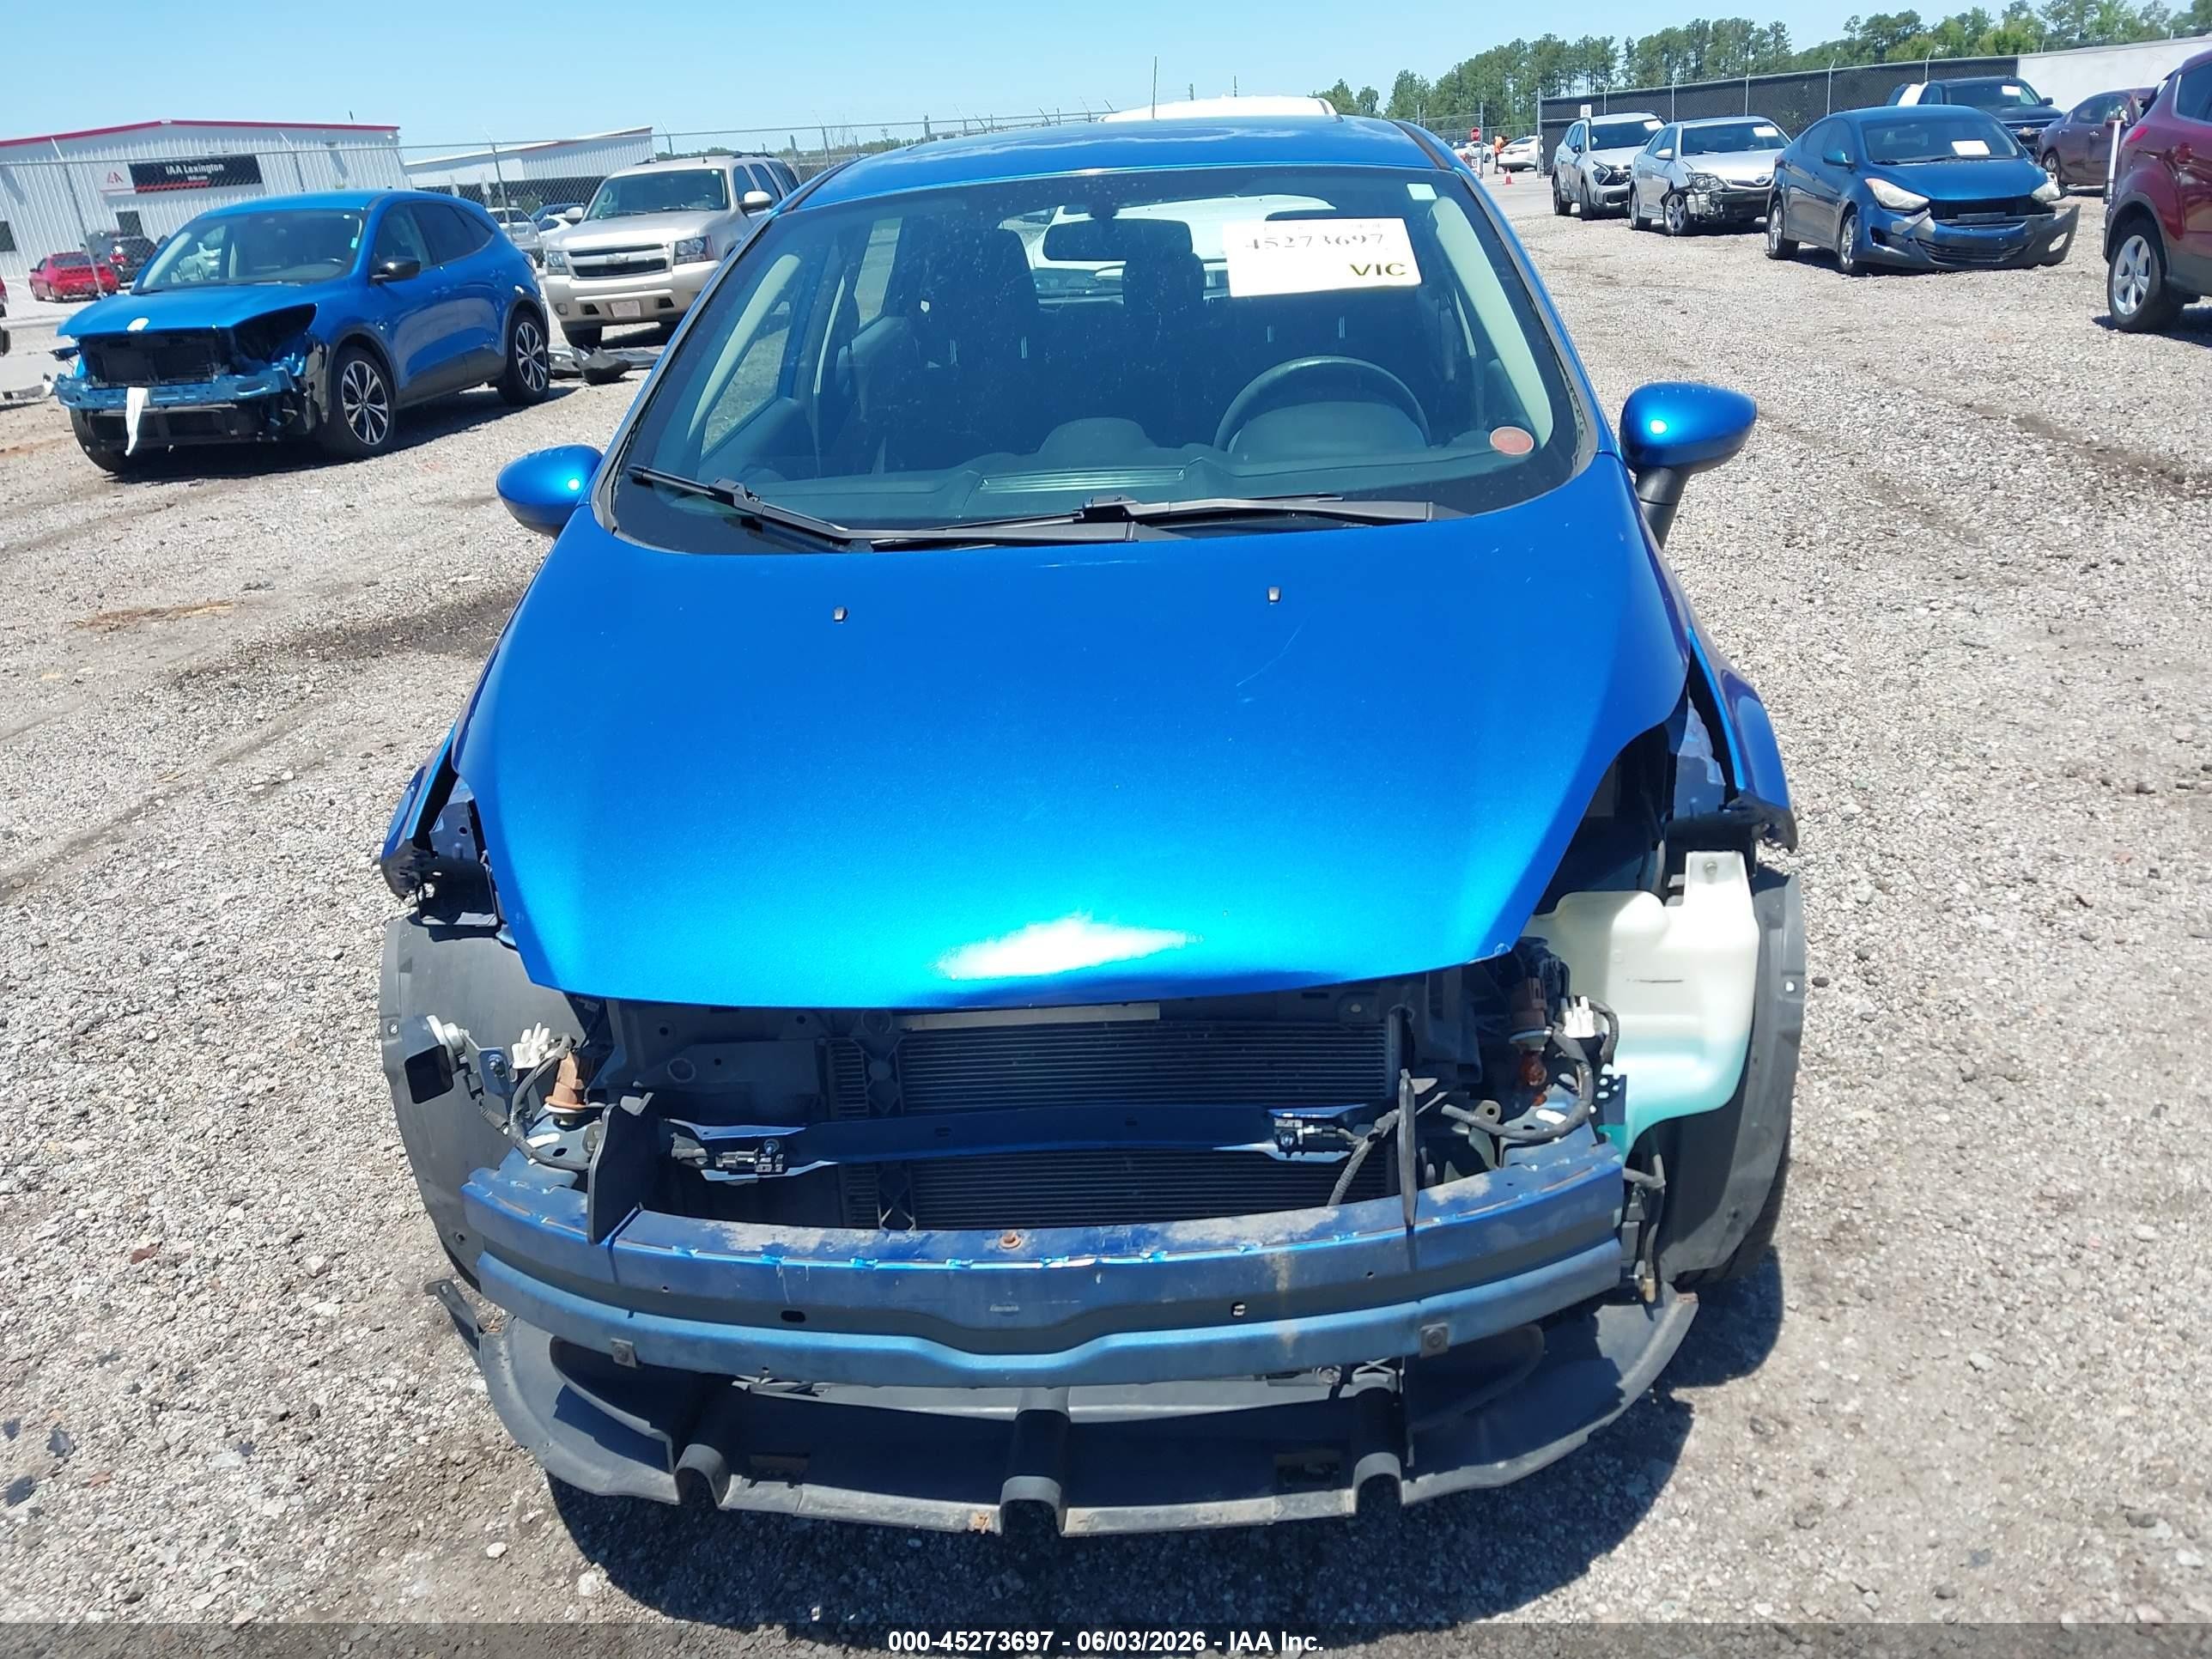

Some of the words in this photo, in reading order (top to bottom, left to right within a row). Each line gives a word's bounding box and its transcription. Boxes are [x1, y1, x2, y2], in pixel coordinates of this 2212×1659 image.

[165, 166, 183, 175] IAA
[183, 163, 225, 174] Lexington
[1350, 263, 1407, 276] VIC
